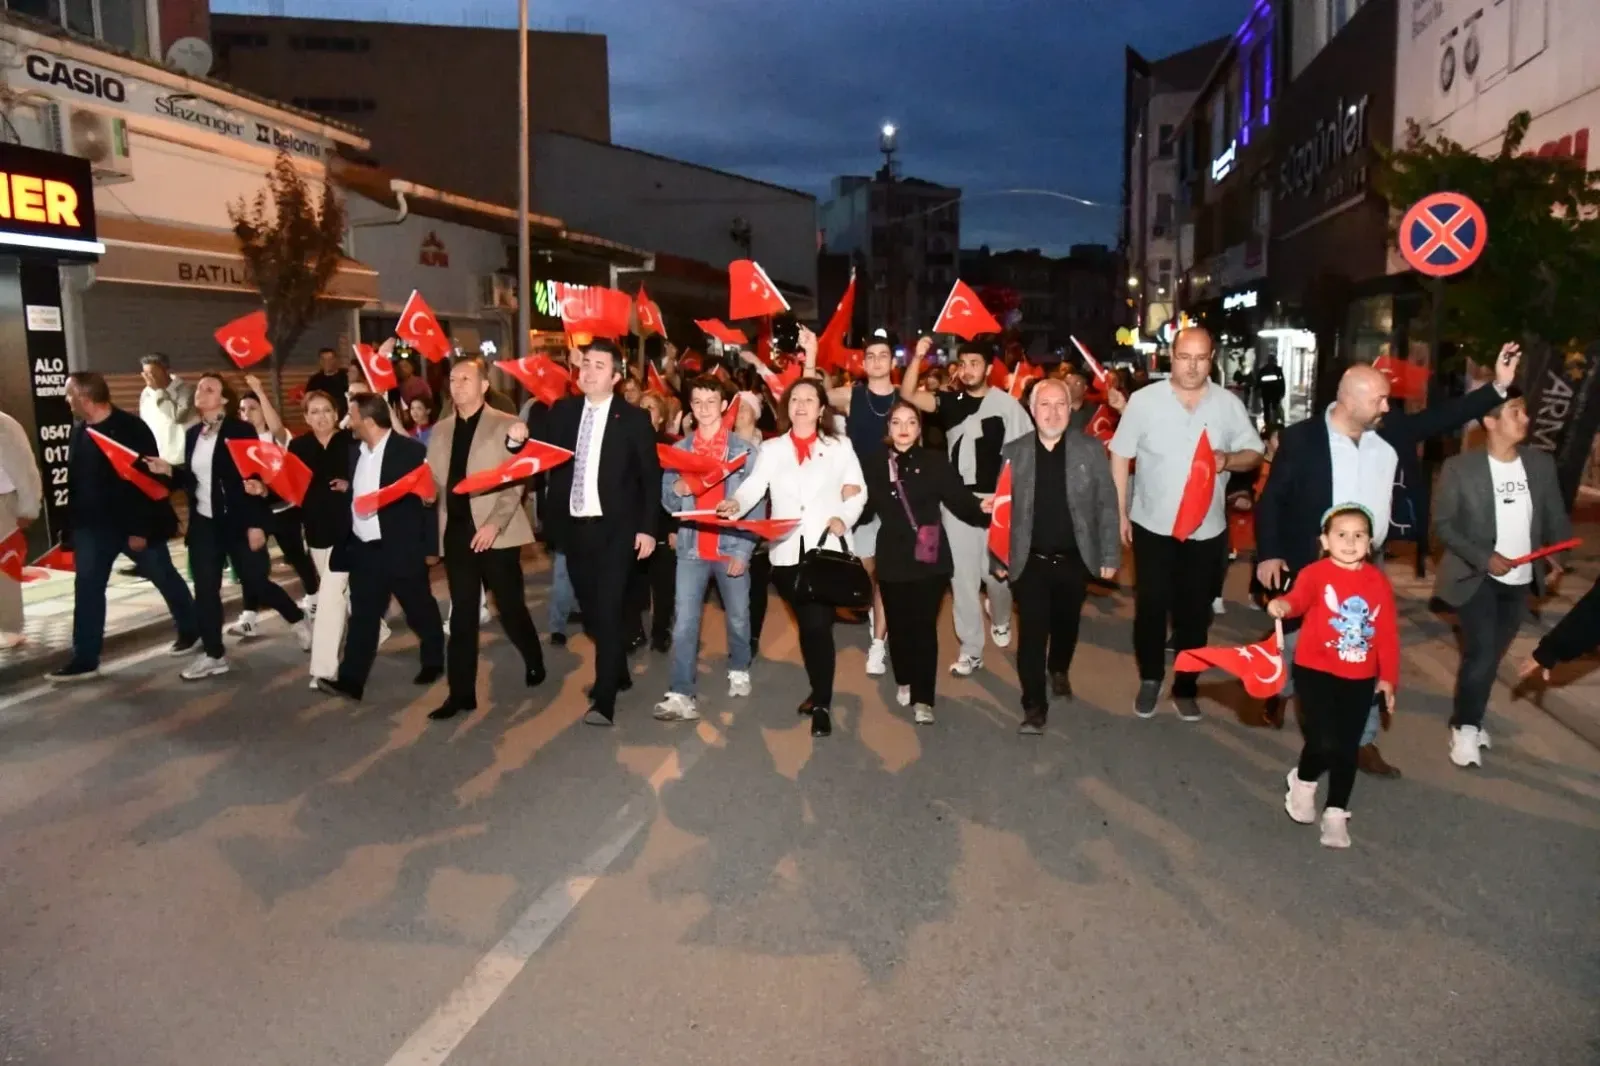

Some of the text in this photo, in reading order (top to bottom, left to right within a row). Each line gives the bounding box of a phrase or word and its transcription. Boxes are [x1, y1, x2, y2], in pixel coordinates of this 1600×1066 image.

[26, 55, 125, 102] CASIO
[154, 96, 245, 135] Slazenger
[0, 172, 81, 227] ER
[35, 358, 64, 373] ALO
[35, 374, 66, 385] PAKET
[1529, 369, 1574, 451] ARM
[40, 424, 72, 441] 0547
[44, 445, 70, 464] 017
[51, 467, 69, 485] 22
